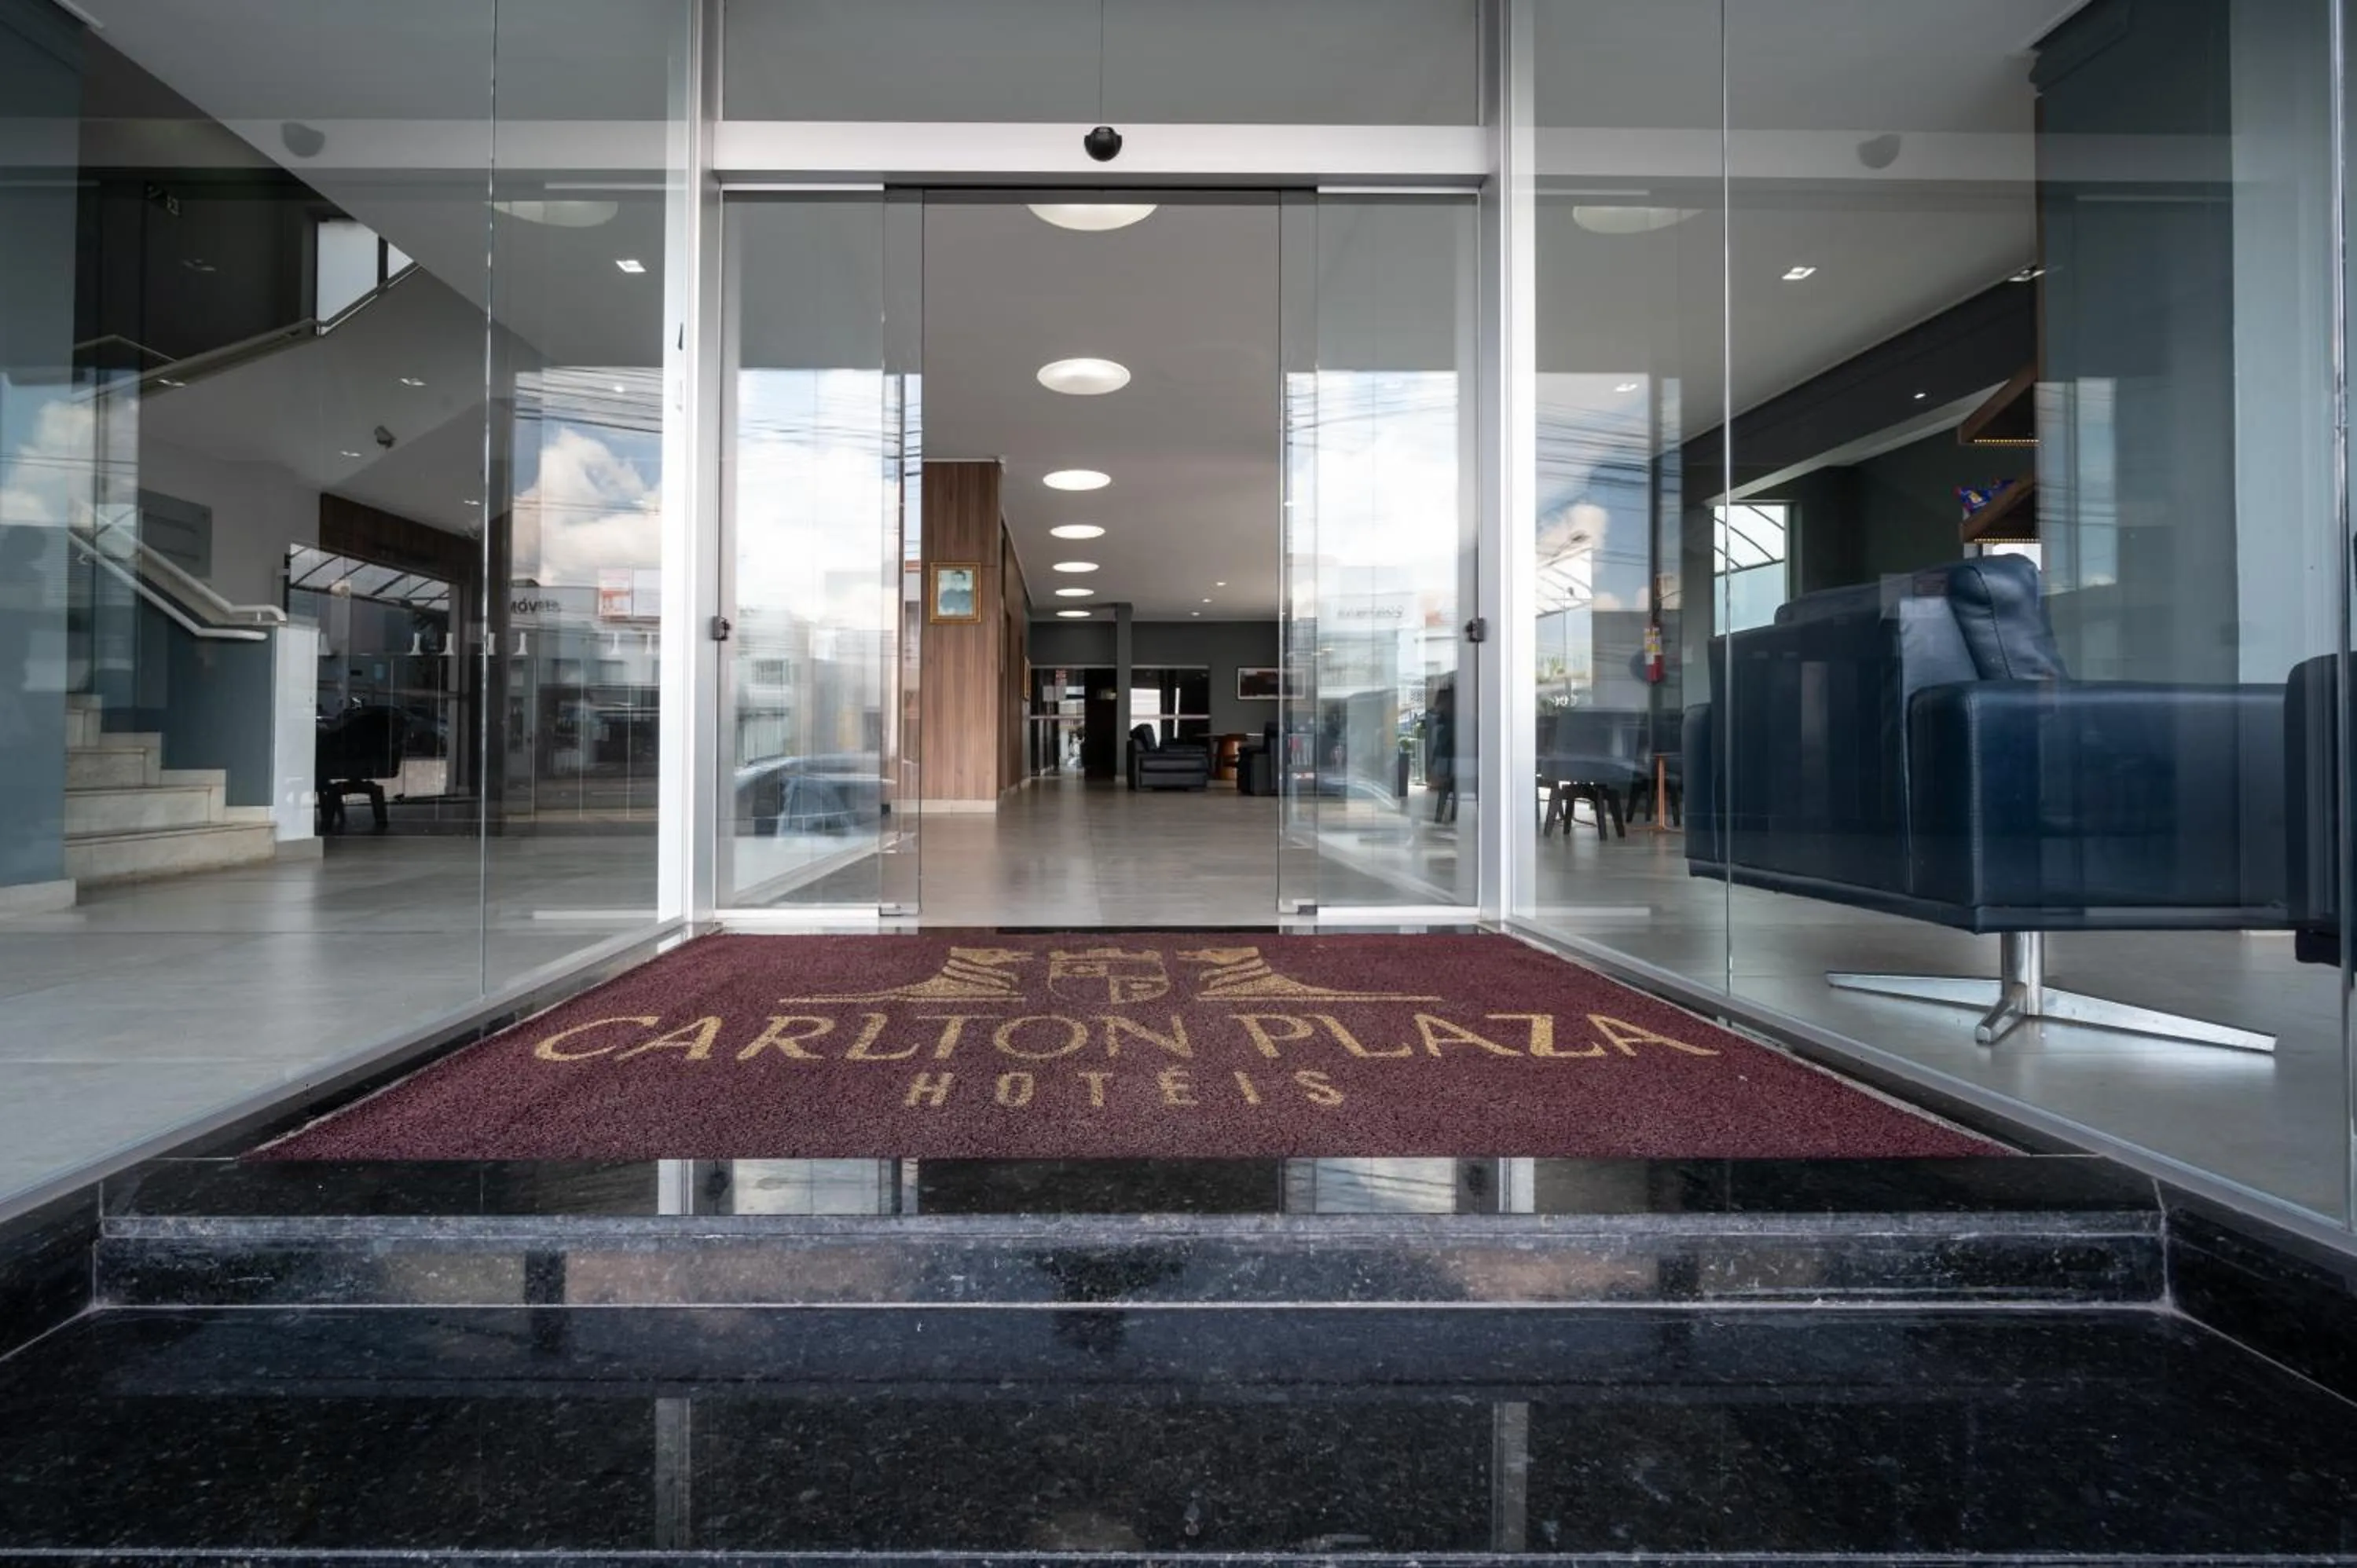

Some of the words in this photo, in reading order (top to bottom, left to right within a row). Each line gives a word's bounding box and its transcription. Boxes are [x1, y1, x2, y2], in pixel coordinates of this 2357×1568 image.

[534, 1012, 1195, 1061] CARLTON
[1230, 1013, 1721, 1058] PLAZA
[905, 1070, 1346, 1108] HOTEIS
